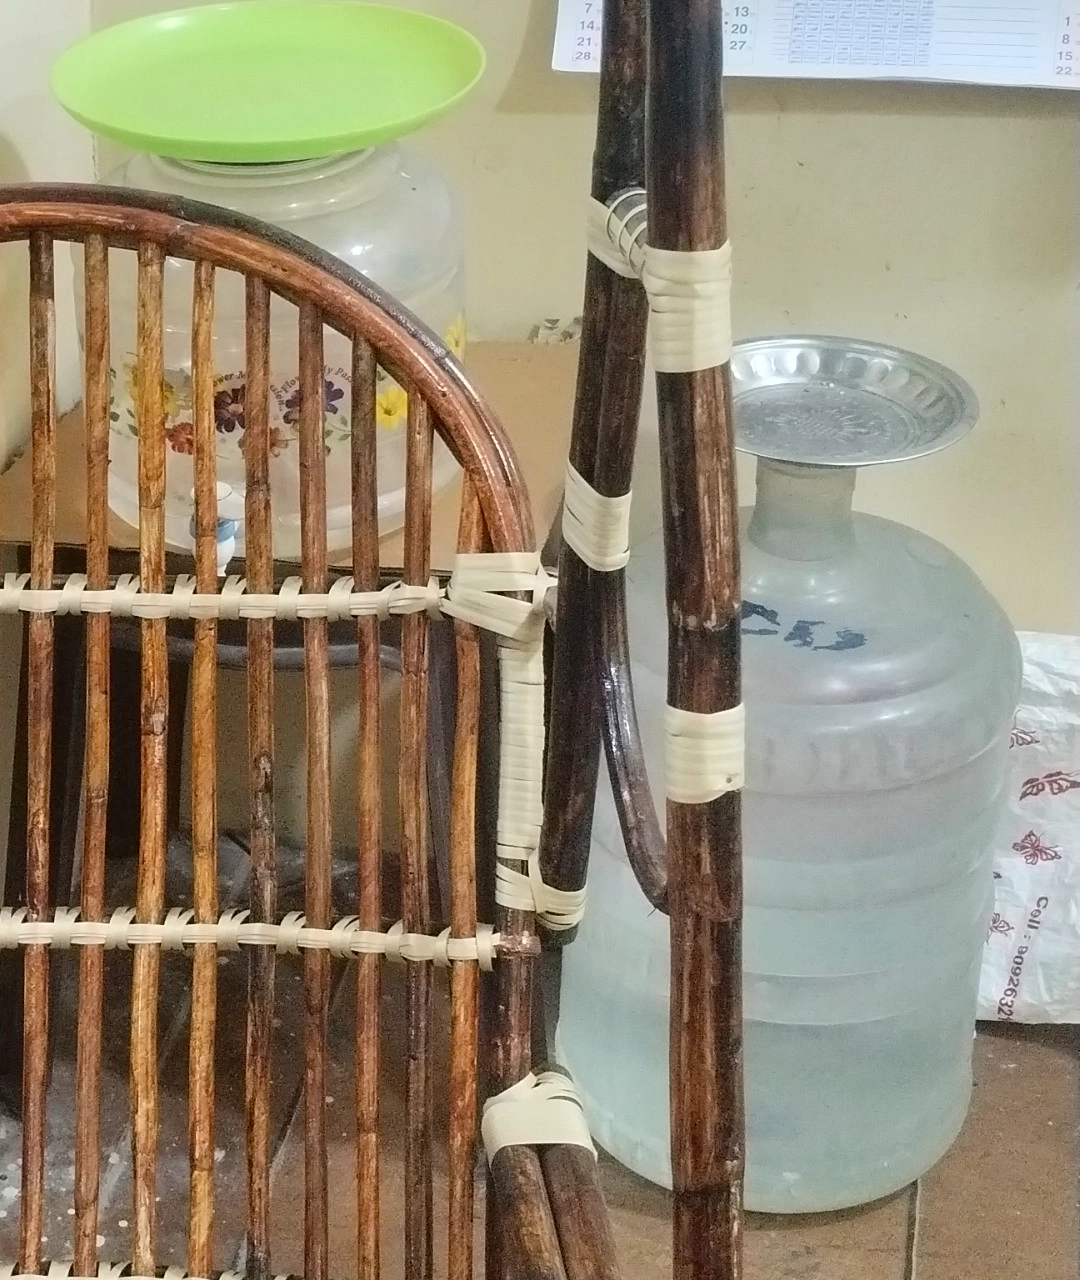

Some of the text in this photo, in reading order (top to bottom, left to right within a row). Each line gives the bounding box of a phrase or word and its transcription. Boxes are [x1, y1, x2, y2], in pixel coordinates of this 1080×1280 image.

[585, 3, 593, 13] 7
[734, 6, 750, 18] 13
[580, 21, 594, 31] 14
[731, 24, 747, 35] 20
[577, 37, 591, 47] 21
[1062, 34, 1070, 44] 8
[729, 41, 747, 51] 27
[575, 52, 591, 61] 28
[1057, 51, 1073, 61] 15
[1056, 66, 1072, 75] 22
[1027, 896, 1049, 930] Cell
